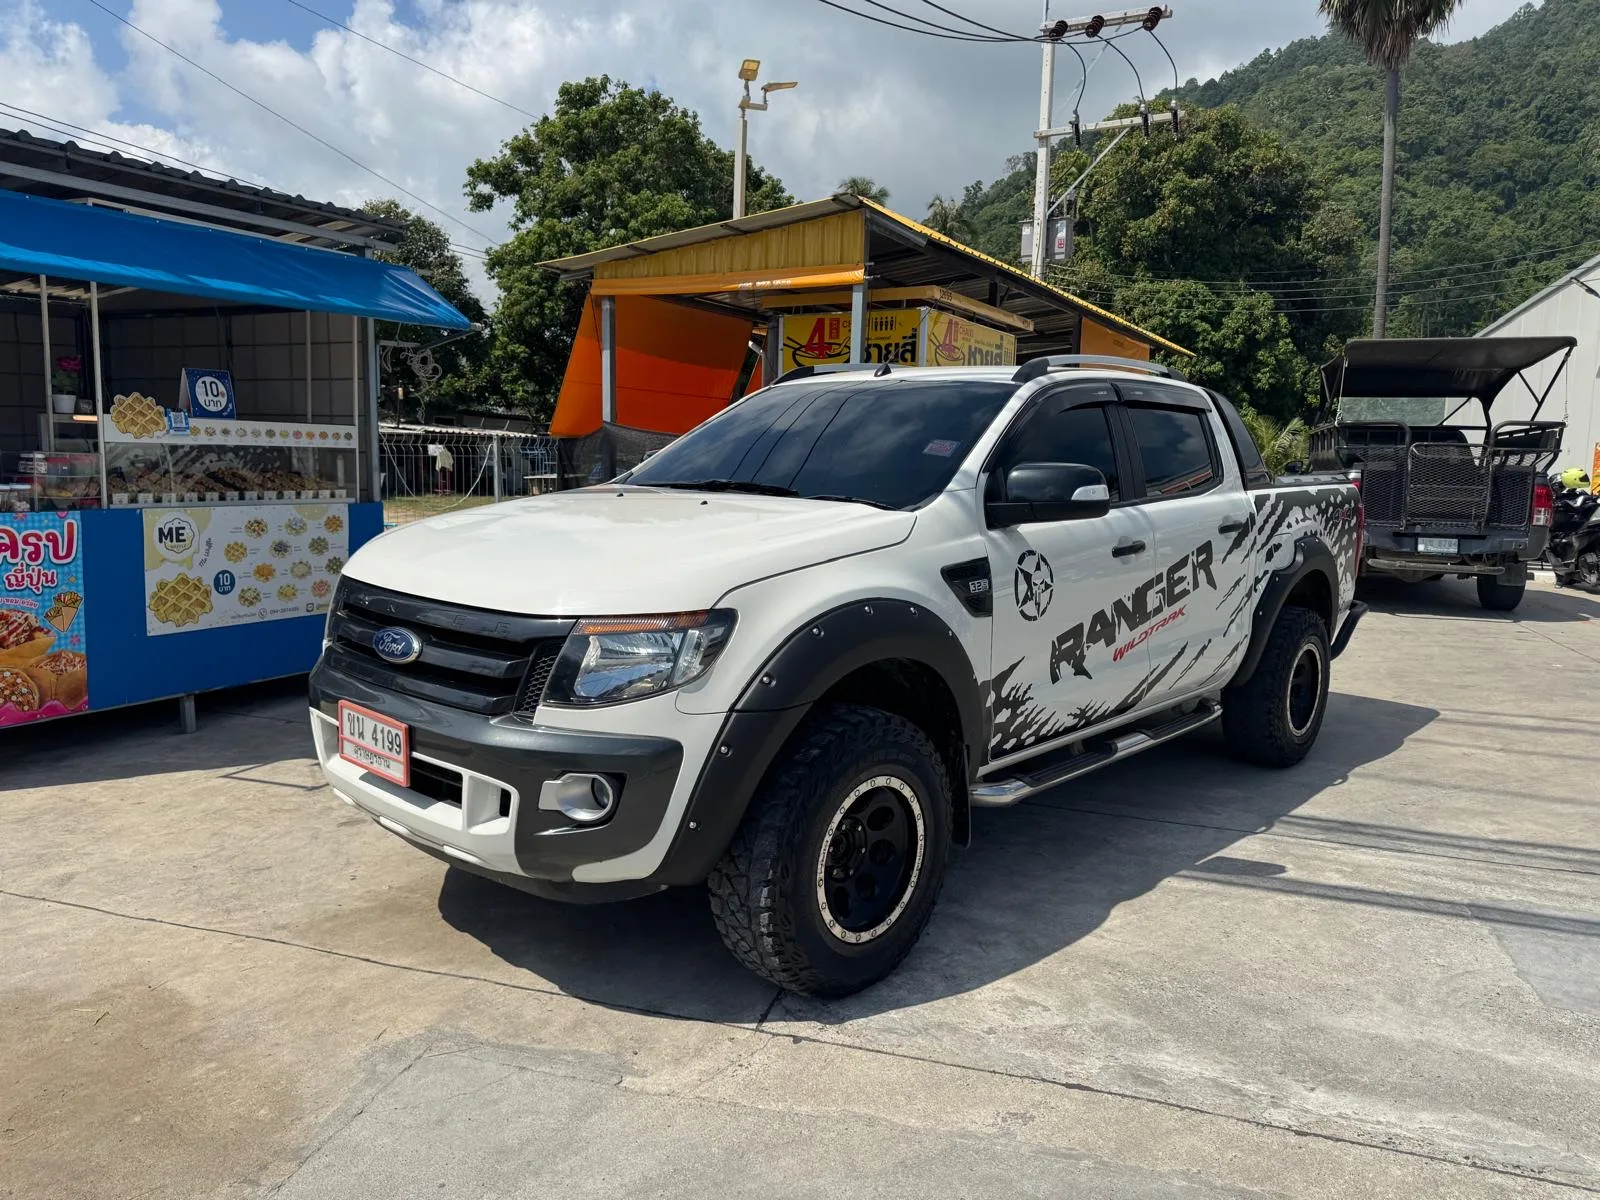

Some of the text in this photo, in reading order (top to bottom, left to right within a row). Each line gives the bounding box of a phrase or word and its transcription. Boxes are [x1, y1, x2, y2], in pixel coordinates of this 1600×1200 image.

[804, 318, 832, 359] 4
[201, 380, 220, 398] 10
[158, 526, 187, 544] ME
[4, 561, 57, 593] ญี่ปุ่น
[218, 573, 231, 586] 10
[1050, 540, 1217, 685] RANGER
[378, 631, 405, 655] Ford
[1112, 605, 1187, 663] WILDTRAK
[347, 711, 402, 756] ขน 4199
